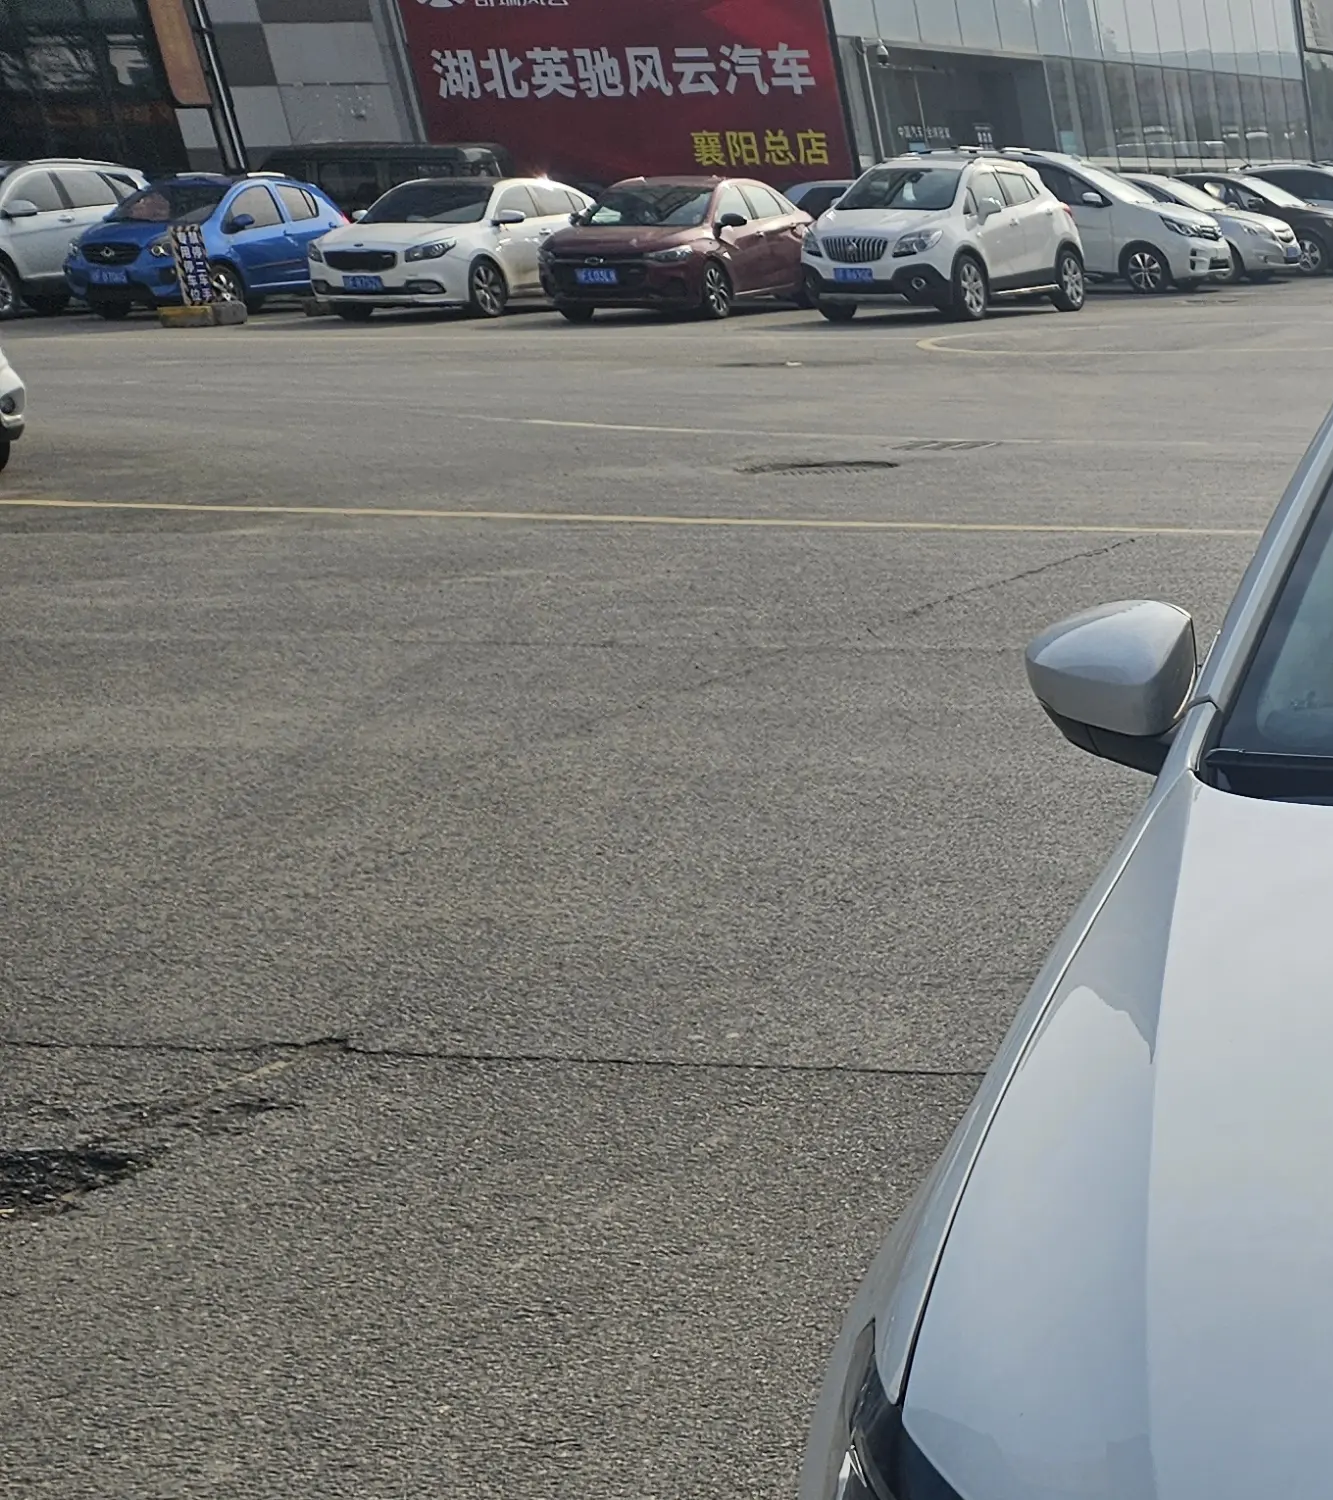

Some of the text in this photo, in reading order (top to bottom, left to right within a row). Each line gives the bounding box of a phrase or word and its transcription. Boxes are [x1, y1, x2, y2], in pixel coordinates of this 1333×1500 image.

[430, 42, 816, 99] 湖北英驰风云汽车
[690, 130, 829, 167] 襄阳总店
